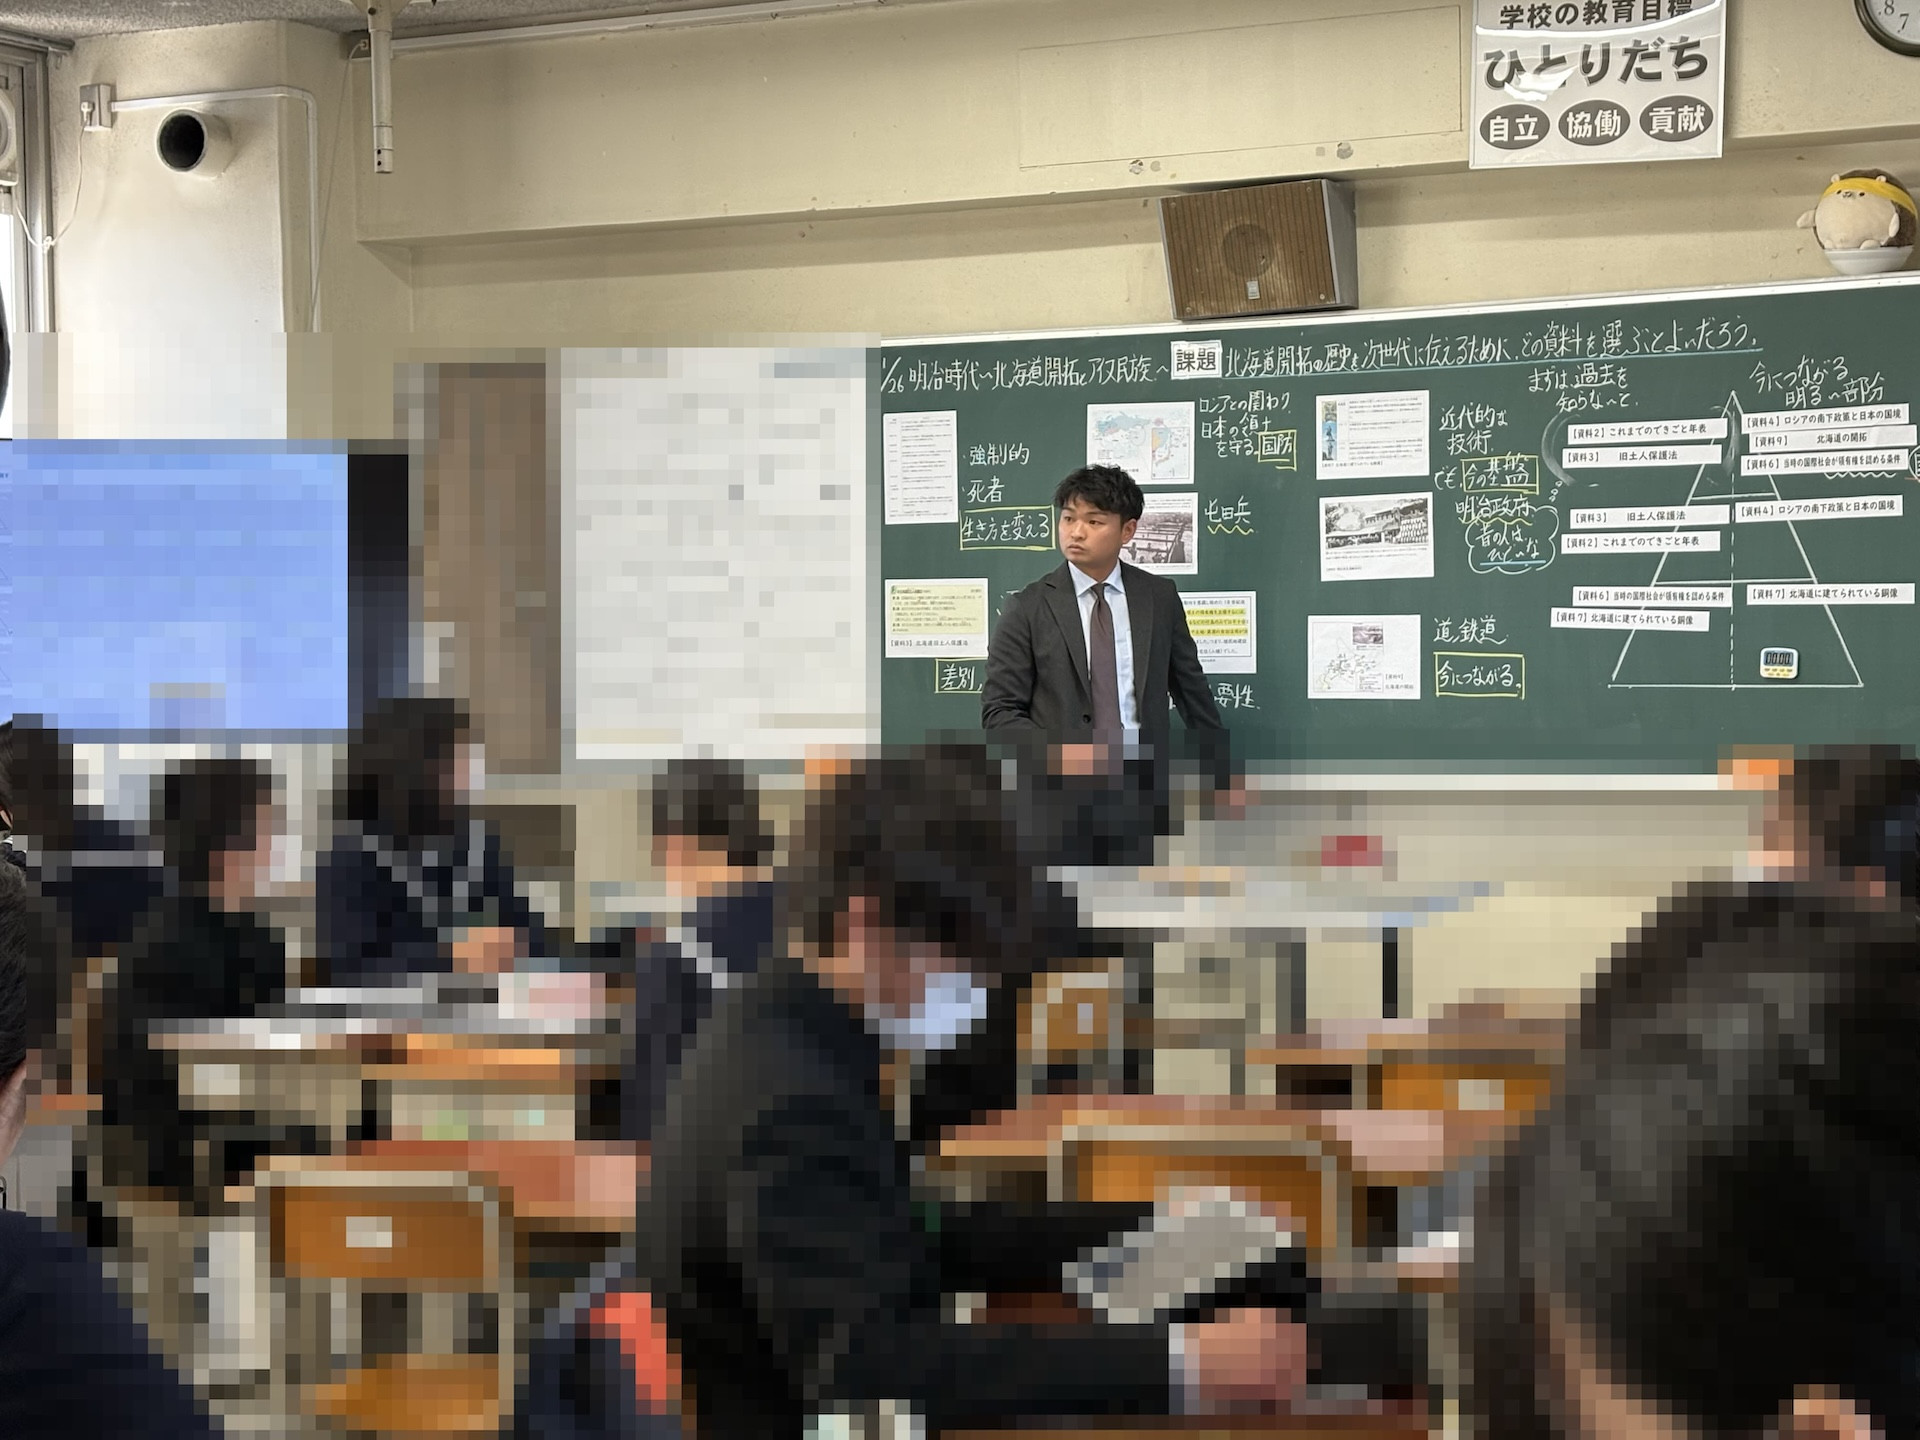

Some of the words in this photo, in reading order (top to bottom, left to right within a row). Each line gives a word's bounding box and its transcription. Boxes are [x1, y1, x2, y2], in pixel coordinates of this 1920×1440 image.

[1884, 0, 1895, 16] 8
[1899, 12, 1910, 30] 7
[1484, 36, 1709, 91] ひとりだち
[1489, 114, 1539, 142] 自立
[1566, 109, 1622, 138] 協働
[1649, 106, 1707, 134] 貢献
[1176, 349, 1217, 373] 課題
[1750, 355, 1849, 394] 今につながる
[1439, 402, 1508, 431] 近代的な
[1261, 434, 1293, 456] 国防
[1816, 431, 1868, 444] 北海道の開拓
[1619, 450, 1678, 460] 旧土人保護法
[1465, 452, 1533, 489] 今の基盤
[967, 475, 1005, 504] 死者
[1204, 495, 1252, 524] 屯田兵
[1627, 510, 1686, 521] 旧土人保護法
[962, 511, 1050, 542] 生き方を変える
